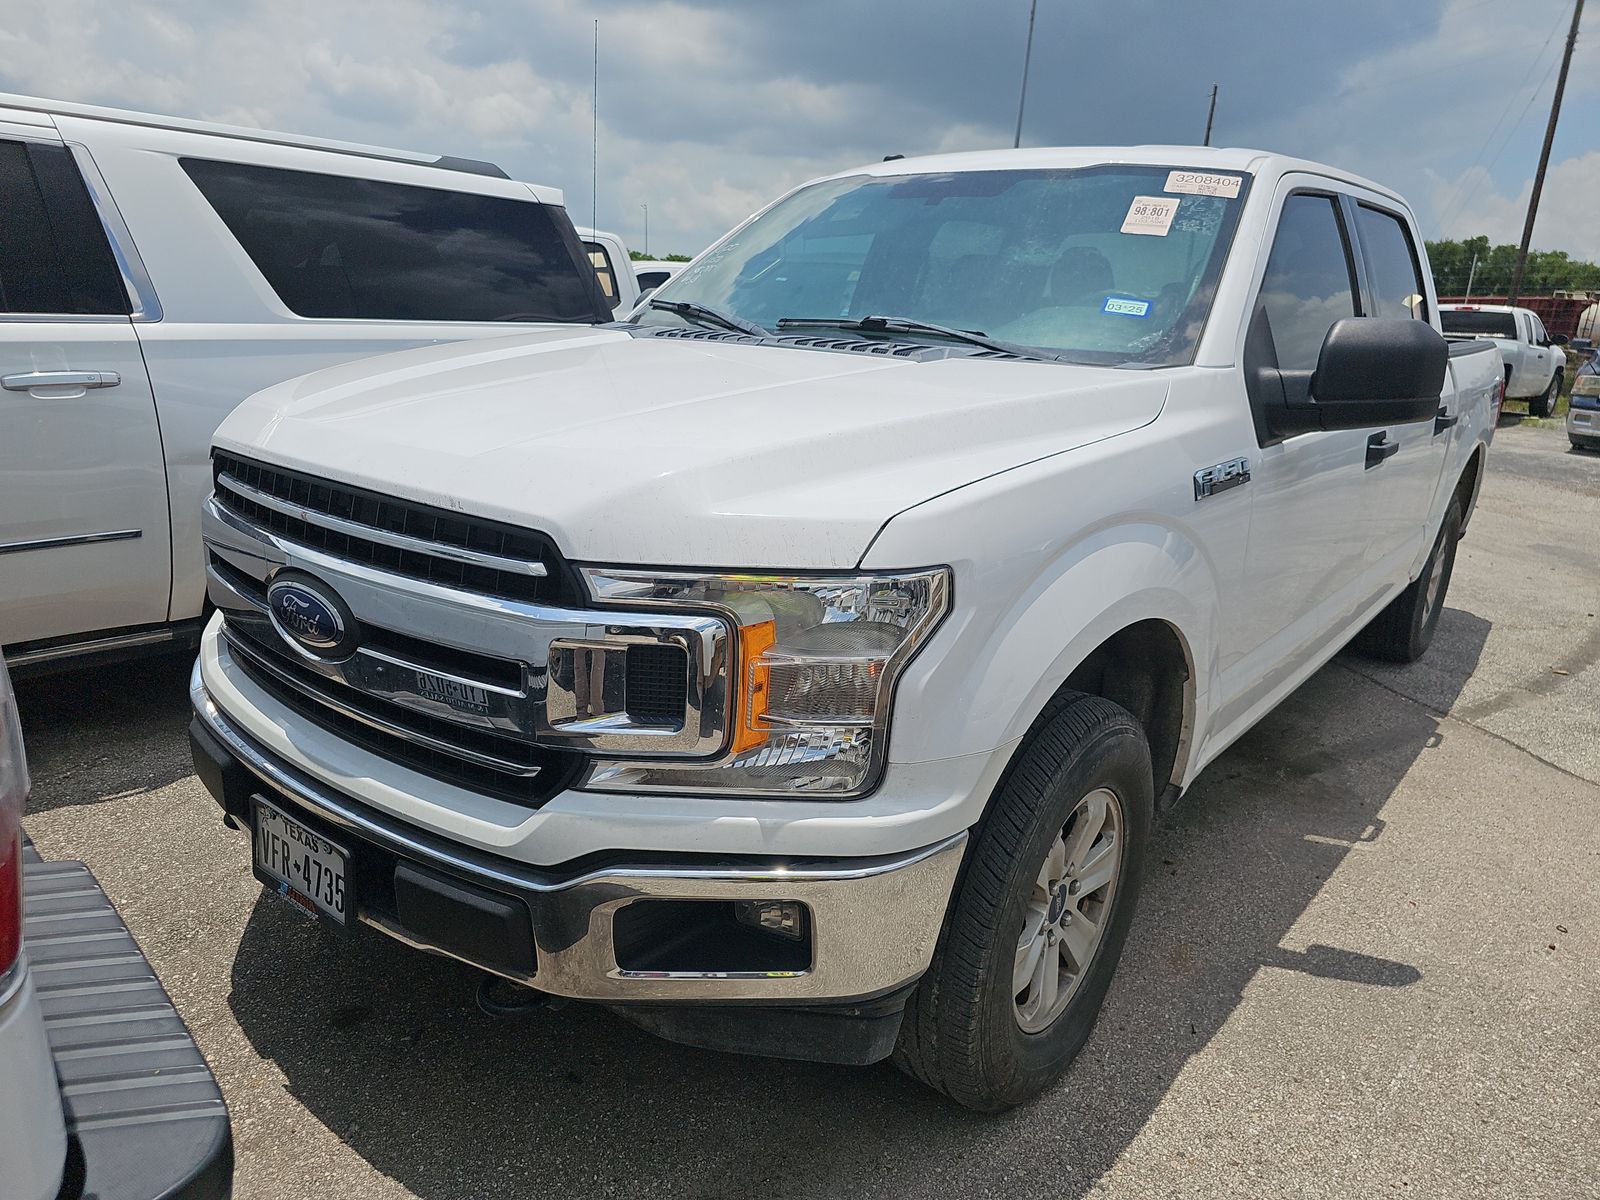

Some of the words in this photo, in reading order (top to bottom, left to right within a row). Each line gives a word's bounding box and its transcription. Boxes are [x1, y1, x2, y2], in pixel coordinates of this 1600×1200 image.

[1176, 174, 1240, 188] 3208404
[1107, 303, 1121, 311] 03
[1127, 305, 1143, 313] 25
[281, 594, 320, 635] Ford
[284, 820, 319, 853] TEXAS
[261, 827, 291, 879] VFR
[302, 854, 345, 913] 4735
